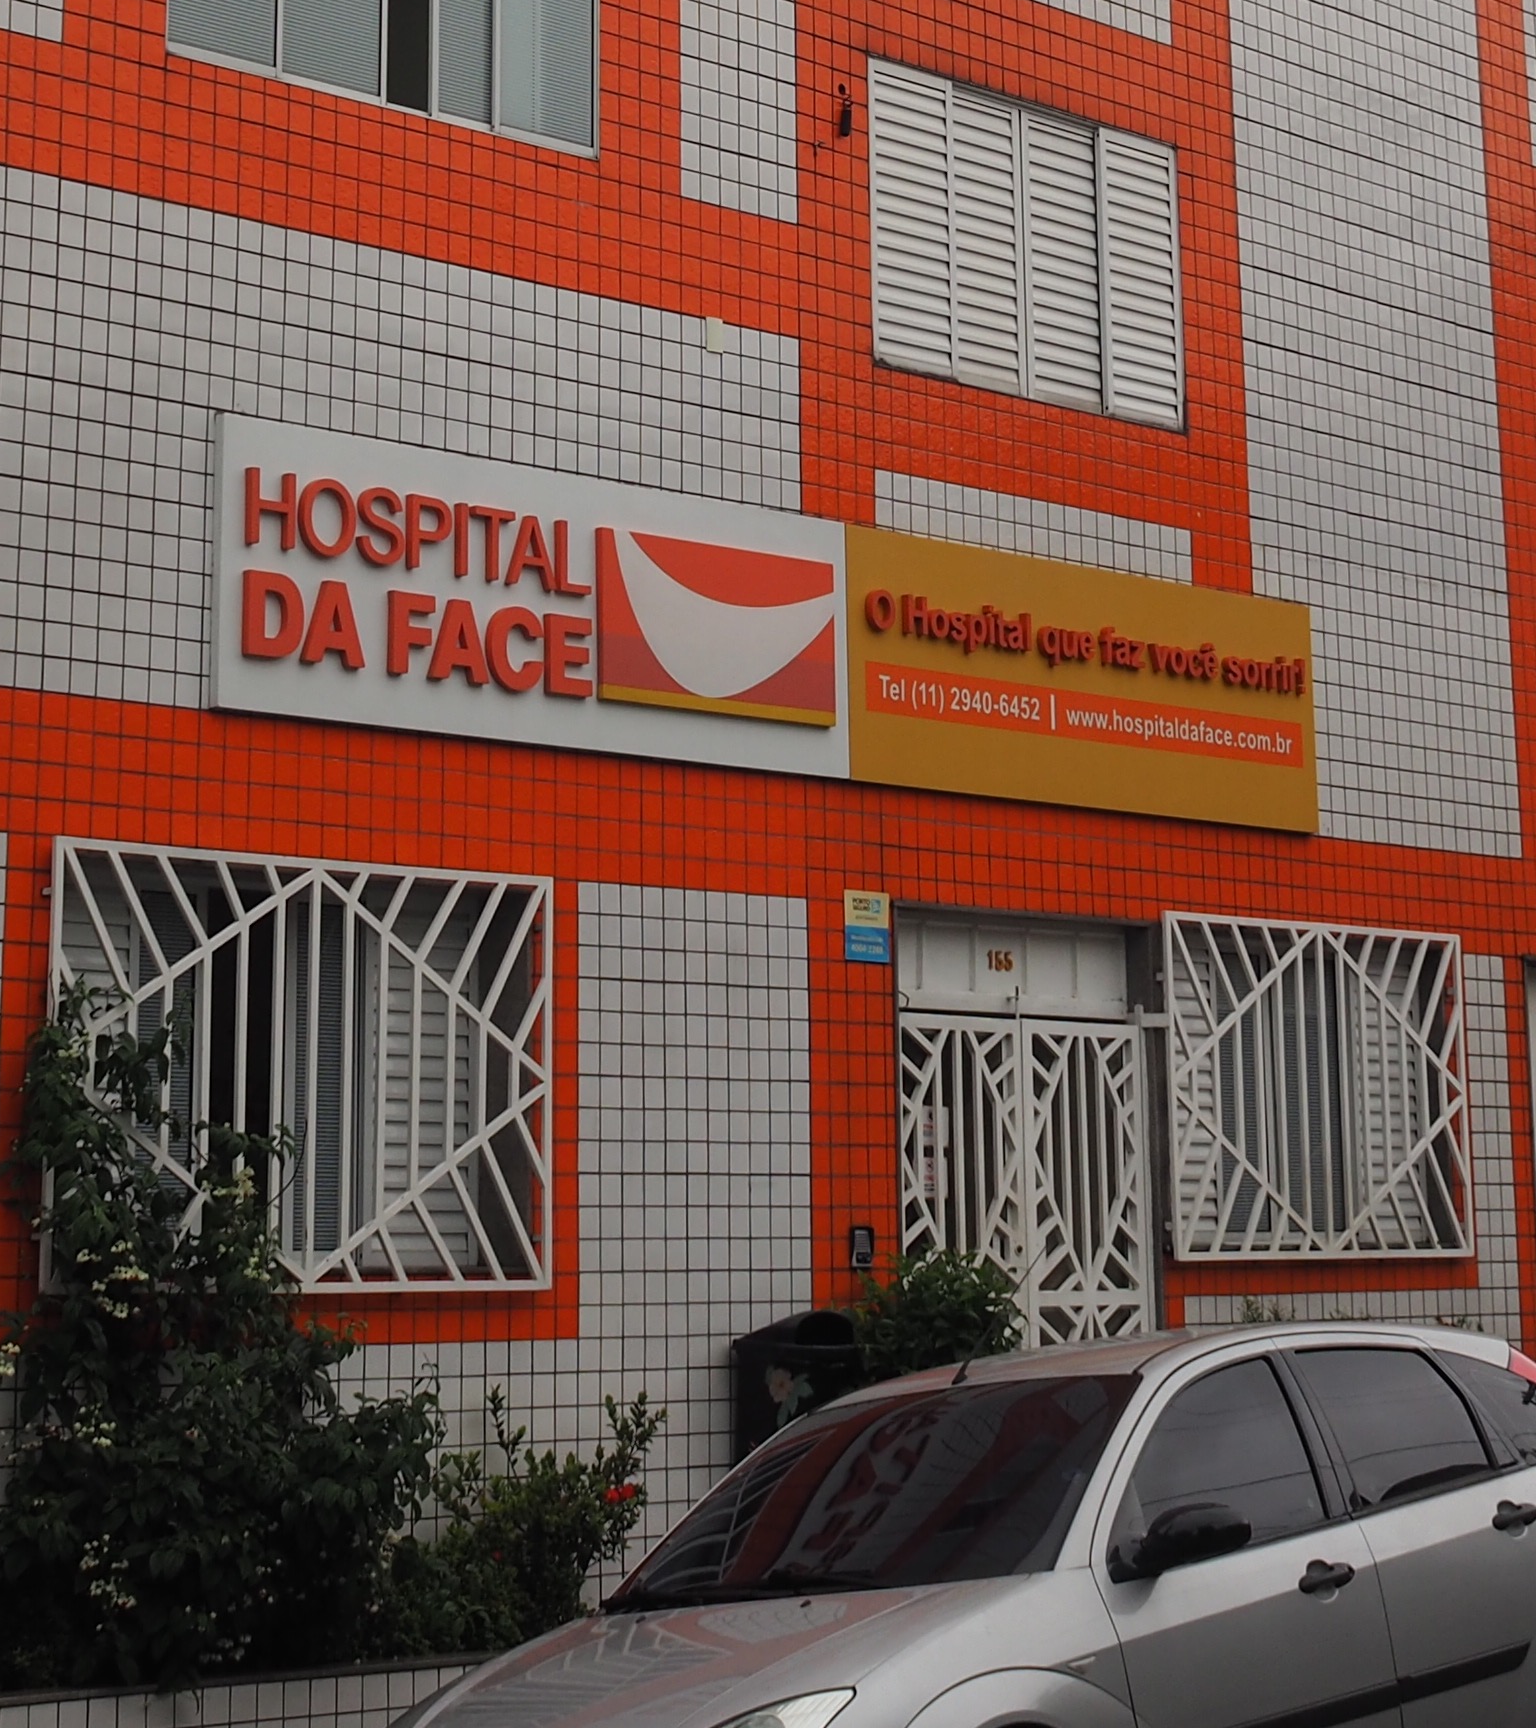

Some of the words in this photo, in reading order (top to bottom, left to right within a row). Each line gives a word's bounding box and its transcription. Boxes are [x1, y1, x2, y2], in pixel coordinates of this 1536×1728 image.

[245, 467, 591, 597] HOSPITAL
[242, 570, 365, 669] DA
[387, 590, 592, 698] FACE
[865, 589, 896, 632] O
[901, 594, 1032, 654] Hospital
[1037, 626, 1096, 667] que
[1098, 626, 1146, 670] faz
[1147, 643, 1219, 679] você
[1222, 656, 1307, 696] sorrir!
[878, 674, 906, 702] Tel
[911, 680, 945, 714] (11)
[950, 686, 1041, 720] 2940-6452
[1066, 708, 1292, 755] www.hospitaldaface.com.br
